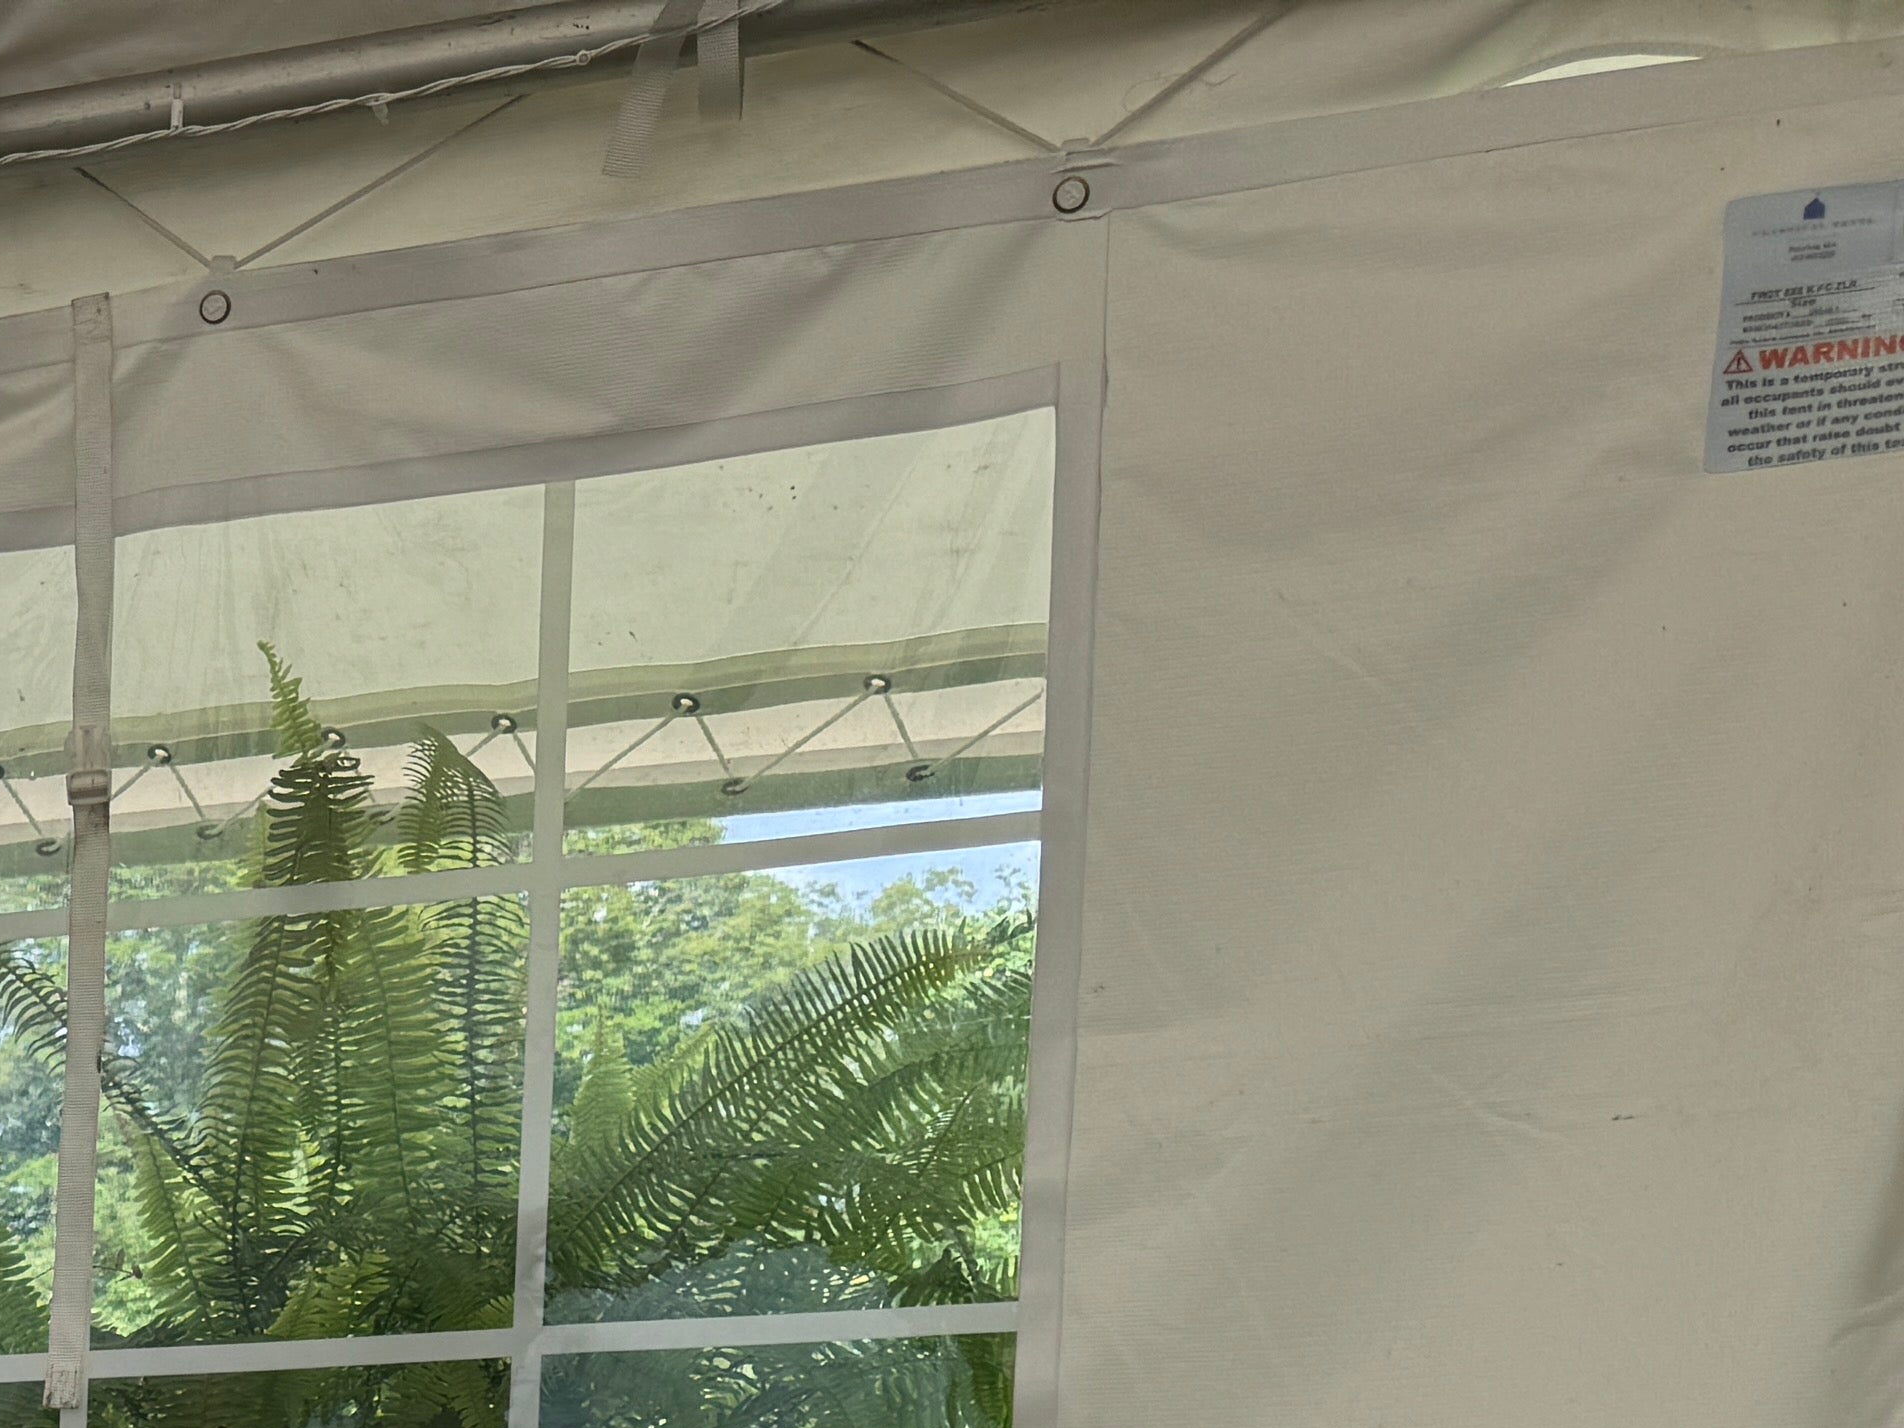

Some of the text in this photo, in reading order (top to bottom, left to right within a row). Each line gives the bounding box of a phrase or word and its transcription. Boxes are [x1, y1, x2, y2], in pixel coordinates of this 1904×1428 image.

[1759, 334, 1904, 371] WARNIN
[1725, 377, 1758, 391] This
[1762, 377, 1775, 387] is
[1793, 364, 1875, 384] temporary
[1721, 395, 1739, 407] all
[1743, 387, 1825, 405] occupants
[1829, 379, 1881, 396] should
[1748, 407, 1776, 420] this
[1782, 403, 1813, 417] tent
[1817, 401, 1832, 413] in
[1727, 421, 1792, 438] weather
[1796, 419, 1812, 430] or
[1816, 415, 1828, 427] if
[1831, 413, 1859, 426] any
[1727, 421, 1901, 453] occur that raise doubt
[1748, 455, 1773, 467] the
[1777, 447, 1826, 464] safety
[1831, 443, 1846, 455] of
[1851, 440, 1880, 454] this
